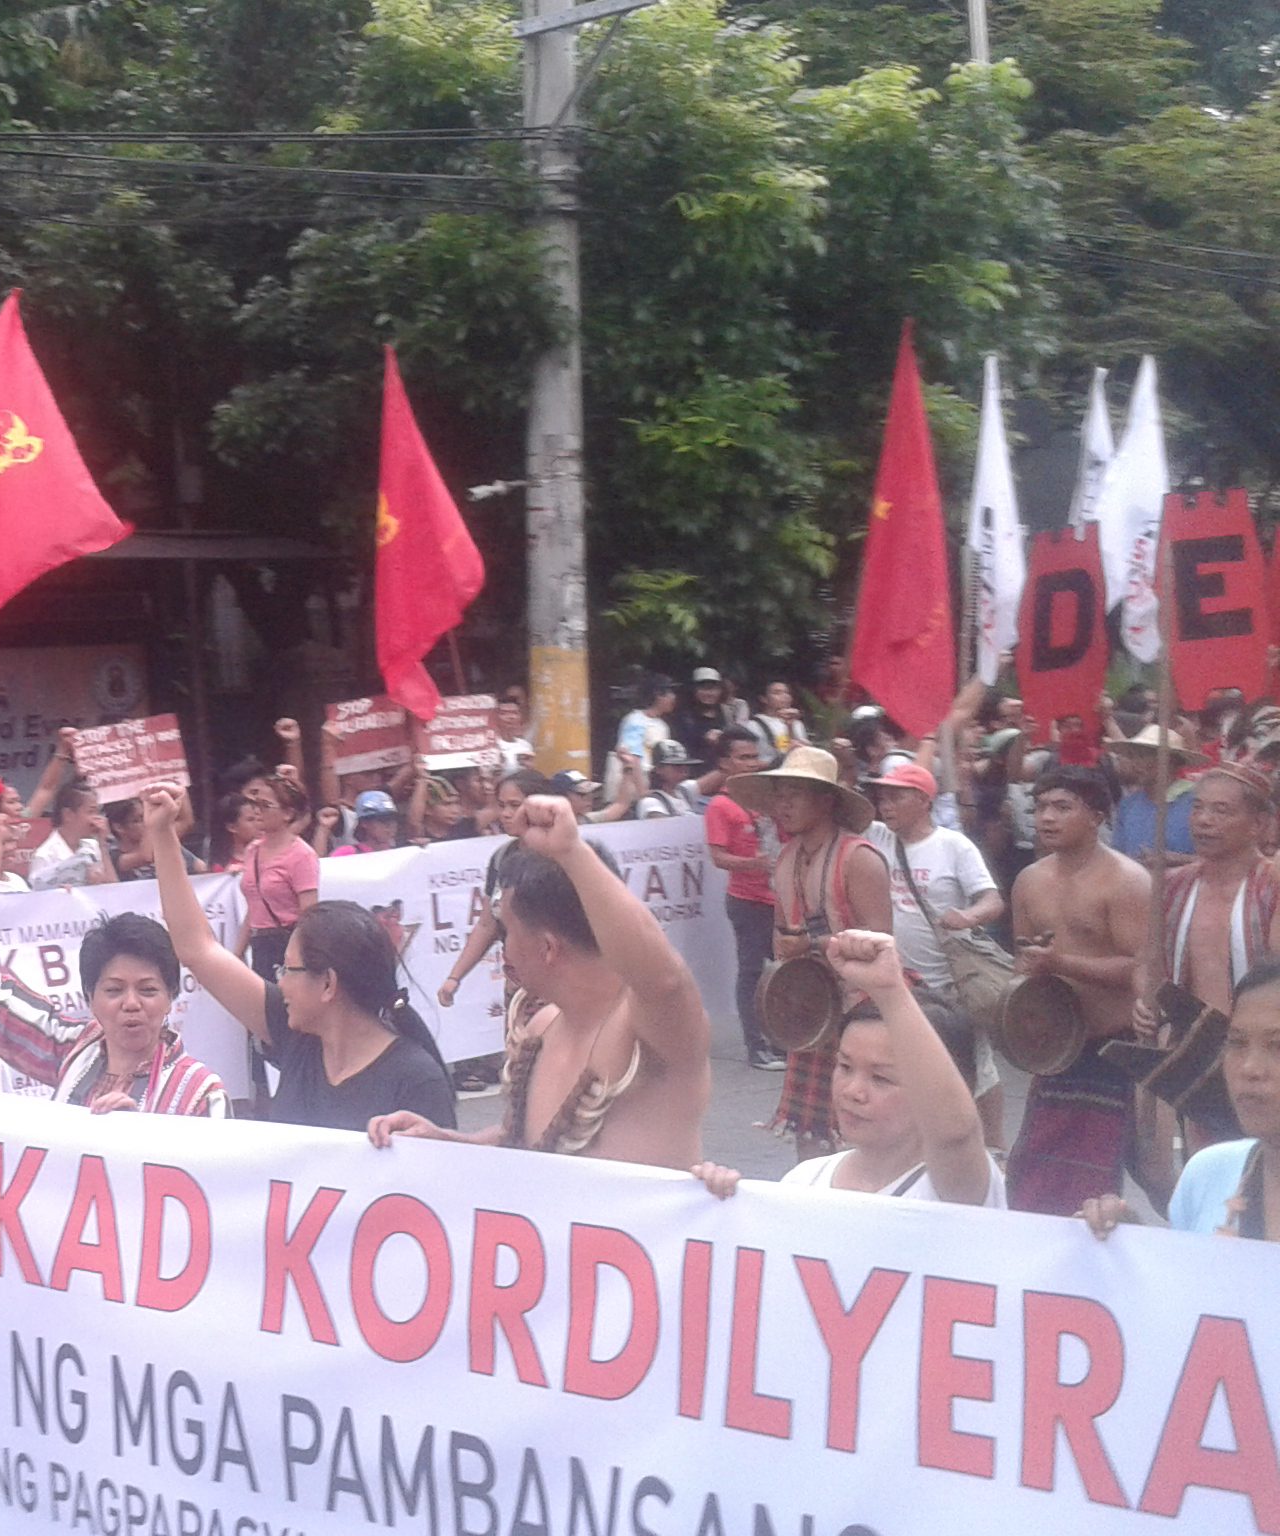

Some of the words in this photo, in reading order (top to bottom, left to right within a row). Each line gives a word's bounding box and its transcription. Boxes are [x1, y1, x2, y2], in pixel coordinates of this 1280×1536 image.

[1031, 568, 1096, 672] D
[1171, 534, 1254, 641] E
[433, 934, 461, 954] NG
[261, 1180, 1280, 1536] KORDILYERA
[11, 1330, 88, 1445] NG
[110, 1354, 261, 1493] MGA
[281, 1394, 884, 1536] PAMBANS
[48, 1462, 310, 1536] PAGPAP
